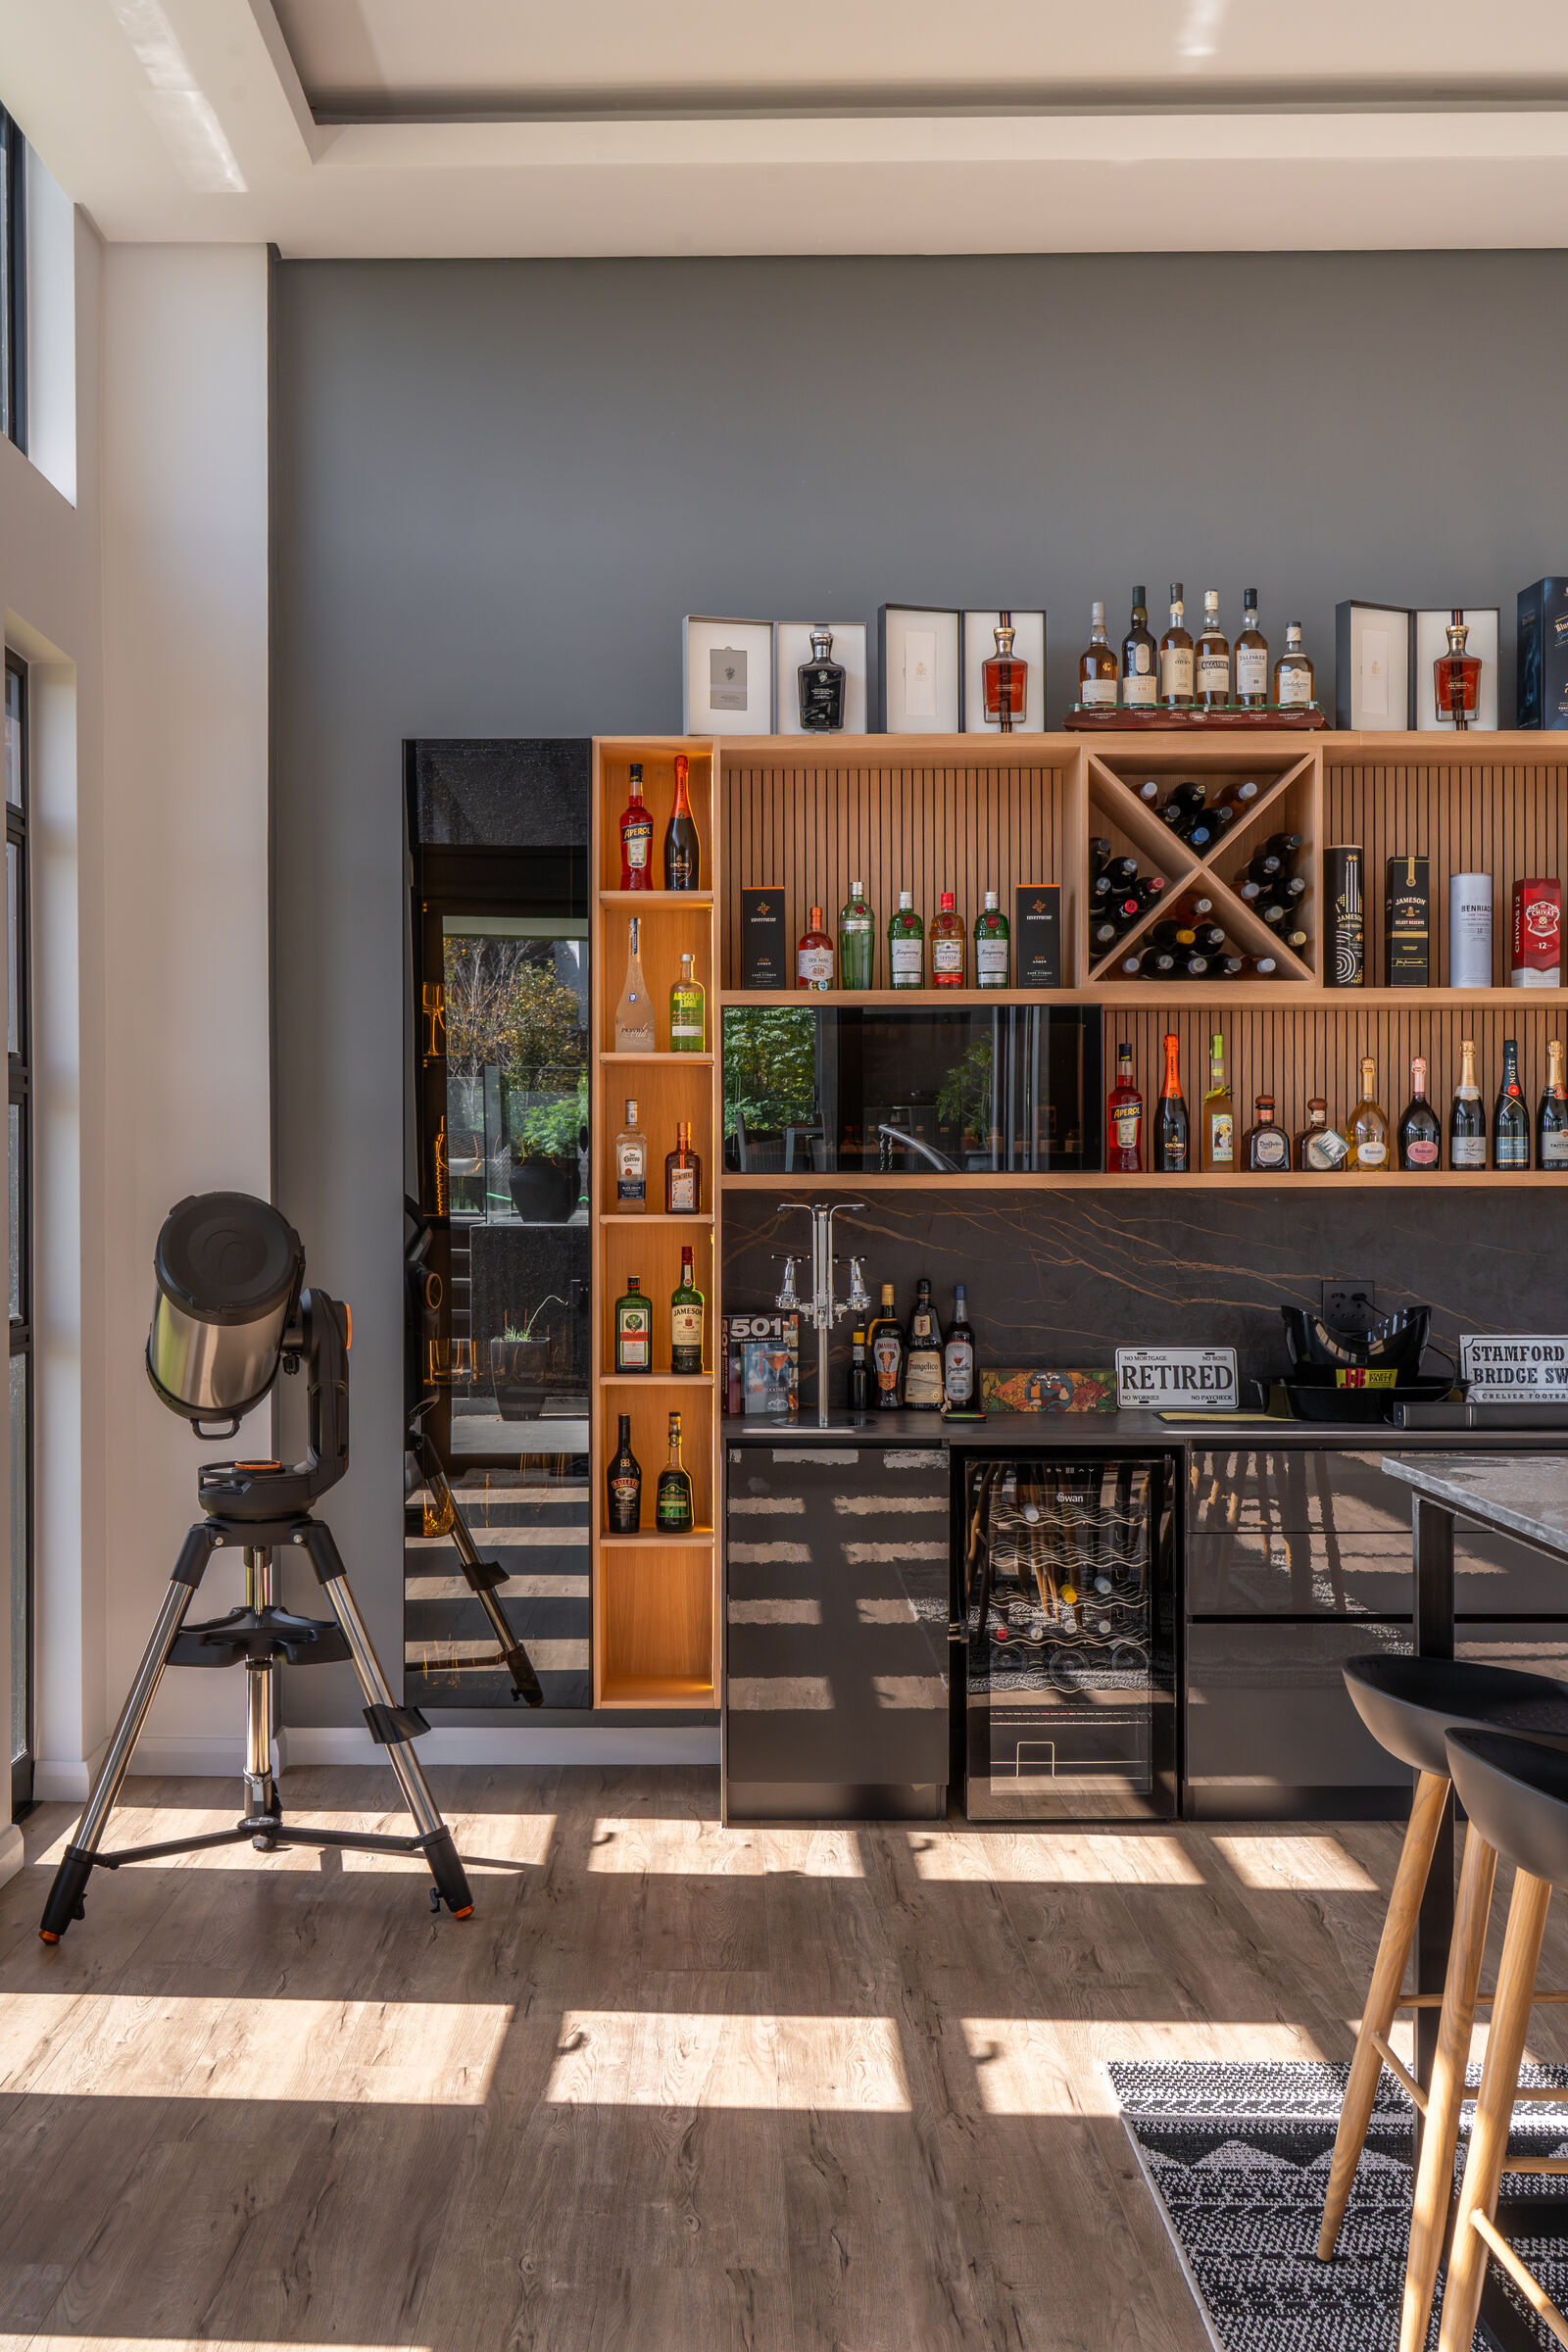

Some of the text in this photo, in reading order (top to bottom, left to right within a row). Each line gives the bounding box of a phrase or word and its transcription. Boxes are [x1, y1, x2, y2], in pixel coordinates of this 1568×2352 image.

[1554, 620, 1568, 633] Blu
[624, 826, 650, 840] APEROL
[1396, 897, 1426, 906] JAMESON
[1113, 1107, 1140, 1119] APEROL
[674, 1308, 702, 1317] JAMESON
[731, 1318, 781, 1338] 501
[1472, 1346, 1565, 1361] STAMFORD
[908, 1359, 939, 1371] Frangelico
[1121, 1365, 1233, 1390] RETIRED
[1473, 1368, 1538, 1384] BRIDGE
[612, 1479, 638, 1489] BAILEYS
[1056, 1492, 1084, 1502] Swan
